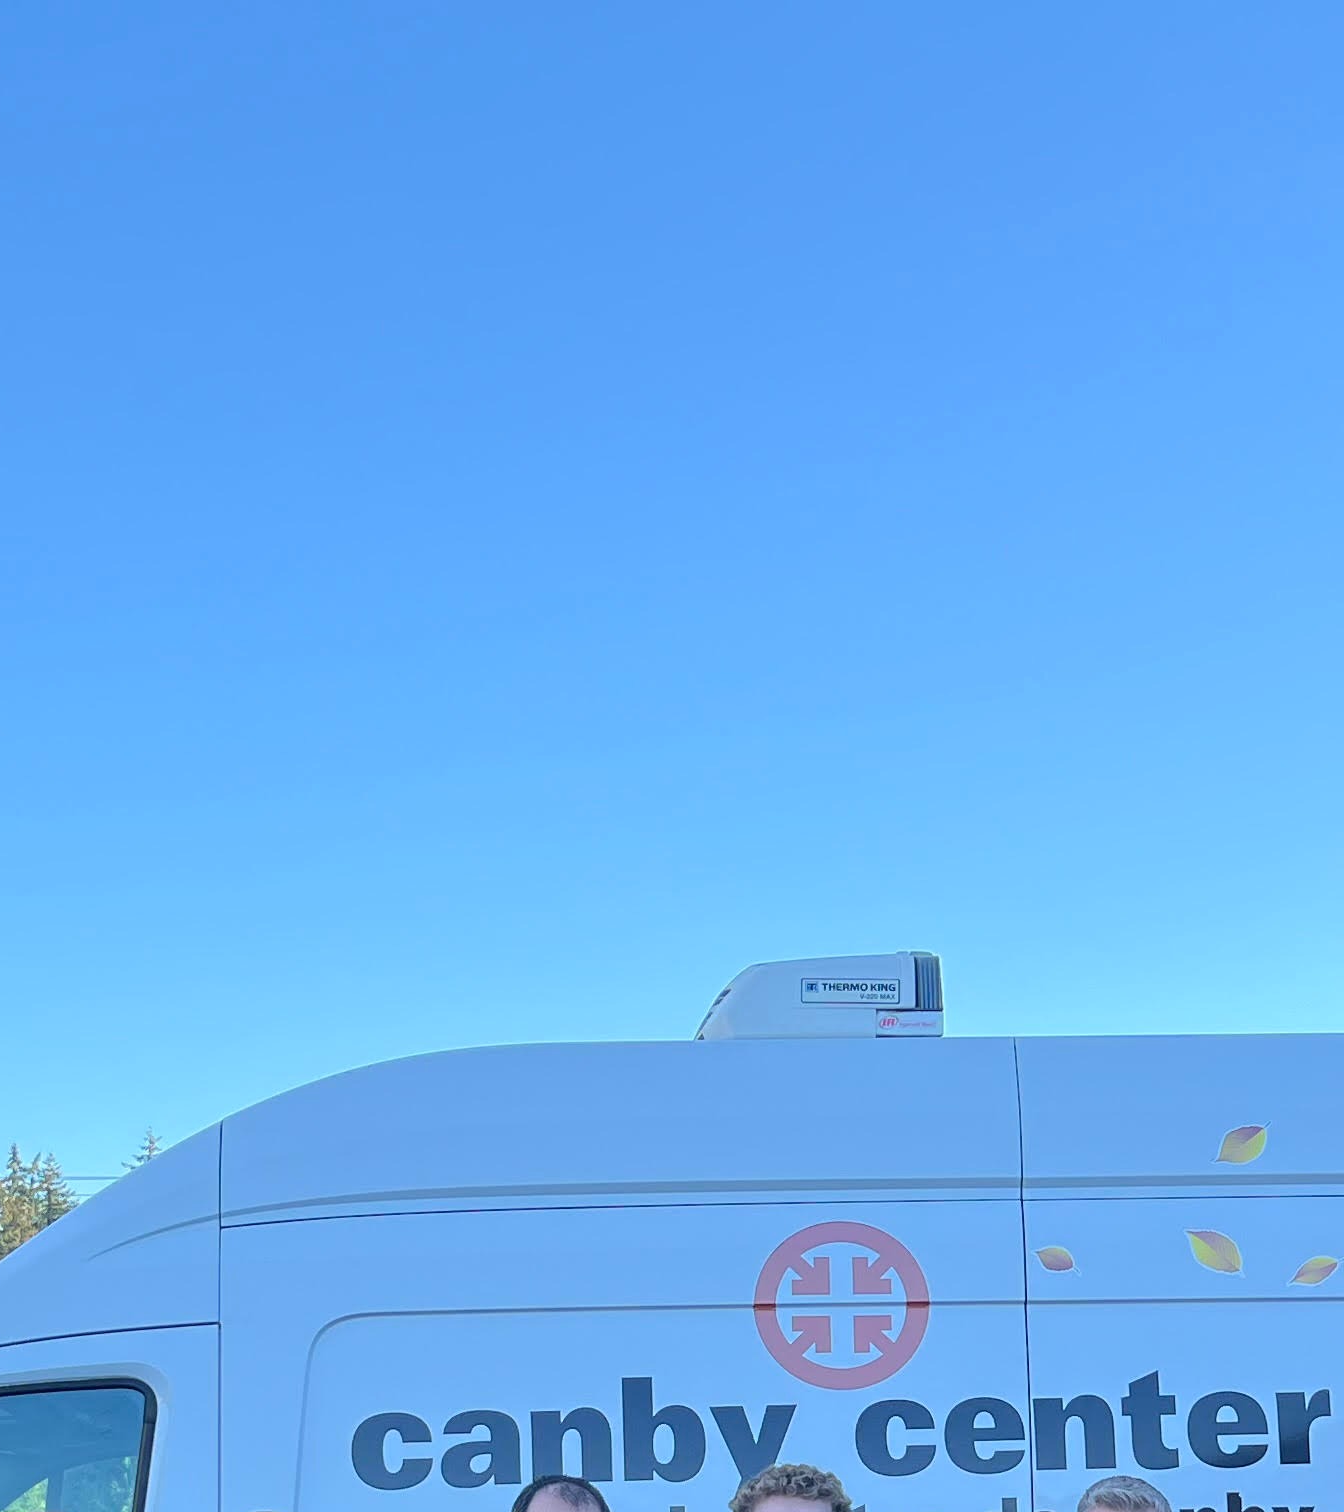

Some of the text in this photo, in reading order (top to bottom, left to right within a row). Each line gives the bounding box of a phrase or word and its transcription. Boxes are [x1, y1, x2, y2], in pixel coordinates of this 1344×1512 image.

[822, 983, 868, 992] THERMO
[870, 984, 896, 992] KING
[351, 1370, 1332, 1492] canby center
